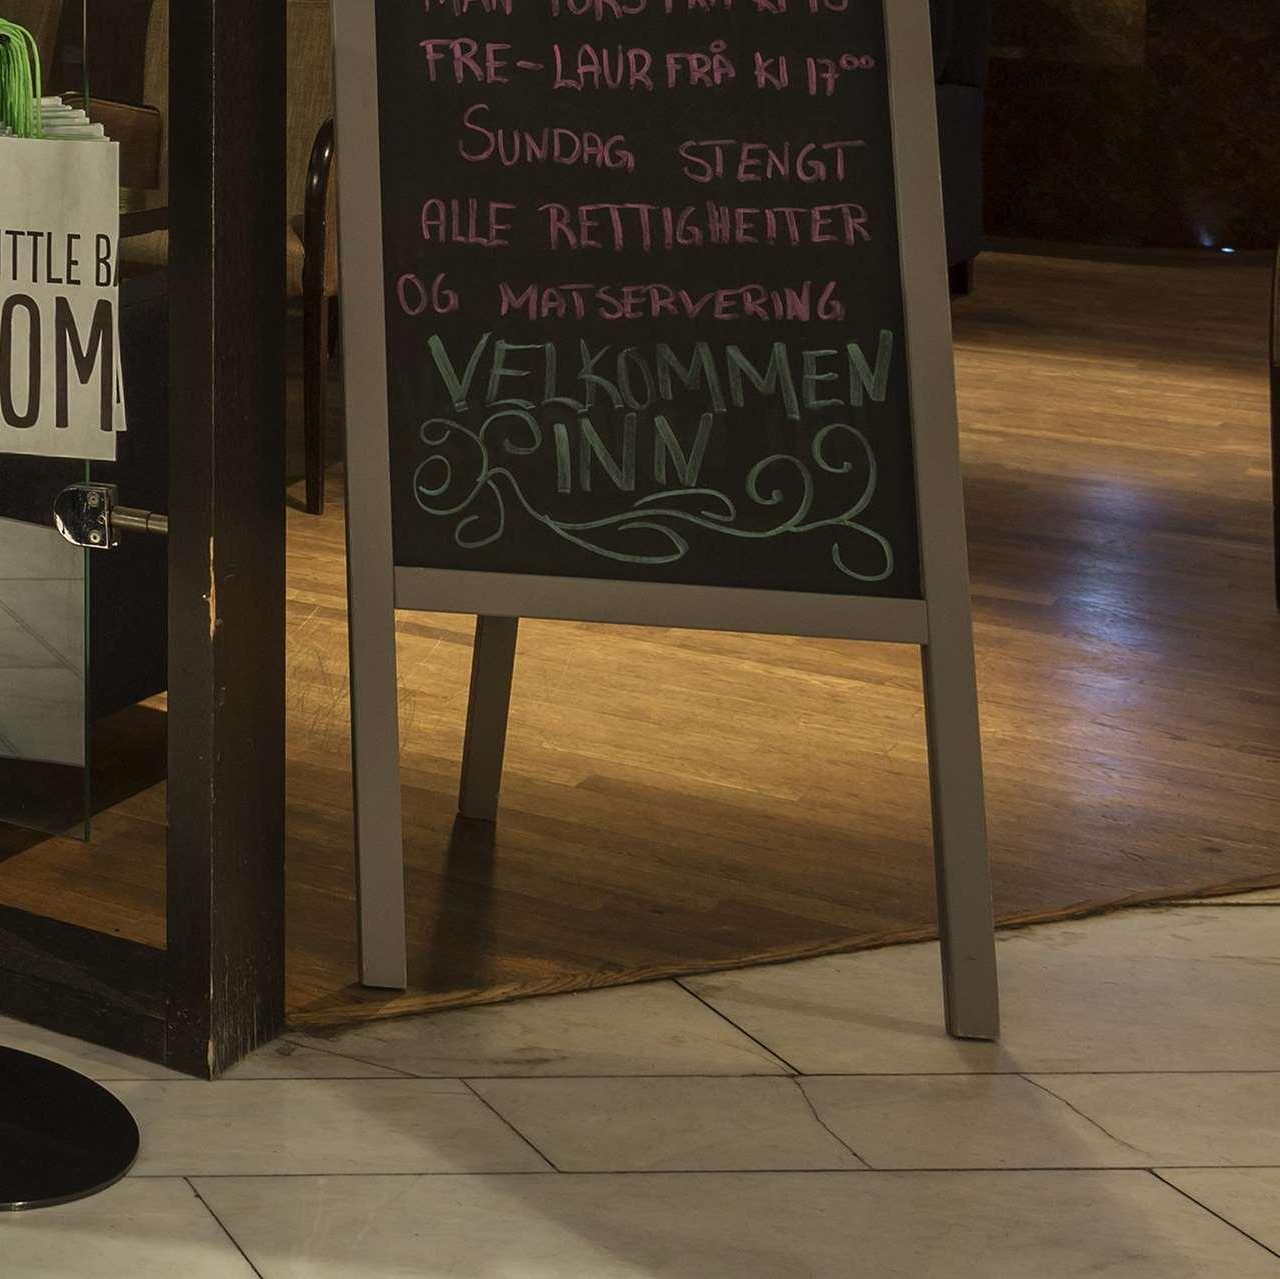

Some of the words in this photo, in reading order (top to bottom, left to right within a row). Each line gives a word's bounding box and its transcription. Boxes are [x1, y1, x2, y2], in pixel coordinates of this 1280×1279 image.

[665, 39, 736, 89] FRÅ
[458, 103, 636, 174] SUNDAG
[677, 138, 867, 184] STENGT
[421, 197, 517, 248] ALLE
[96, 233, 119, 287] B
[396, 272, 460, 317] OG
[499, 279, 847, 321] MATSERVERING
[427, 328, 894, 420] VELKOMMEN
[553, 412, 715, 495] INN
